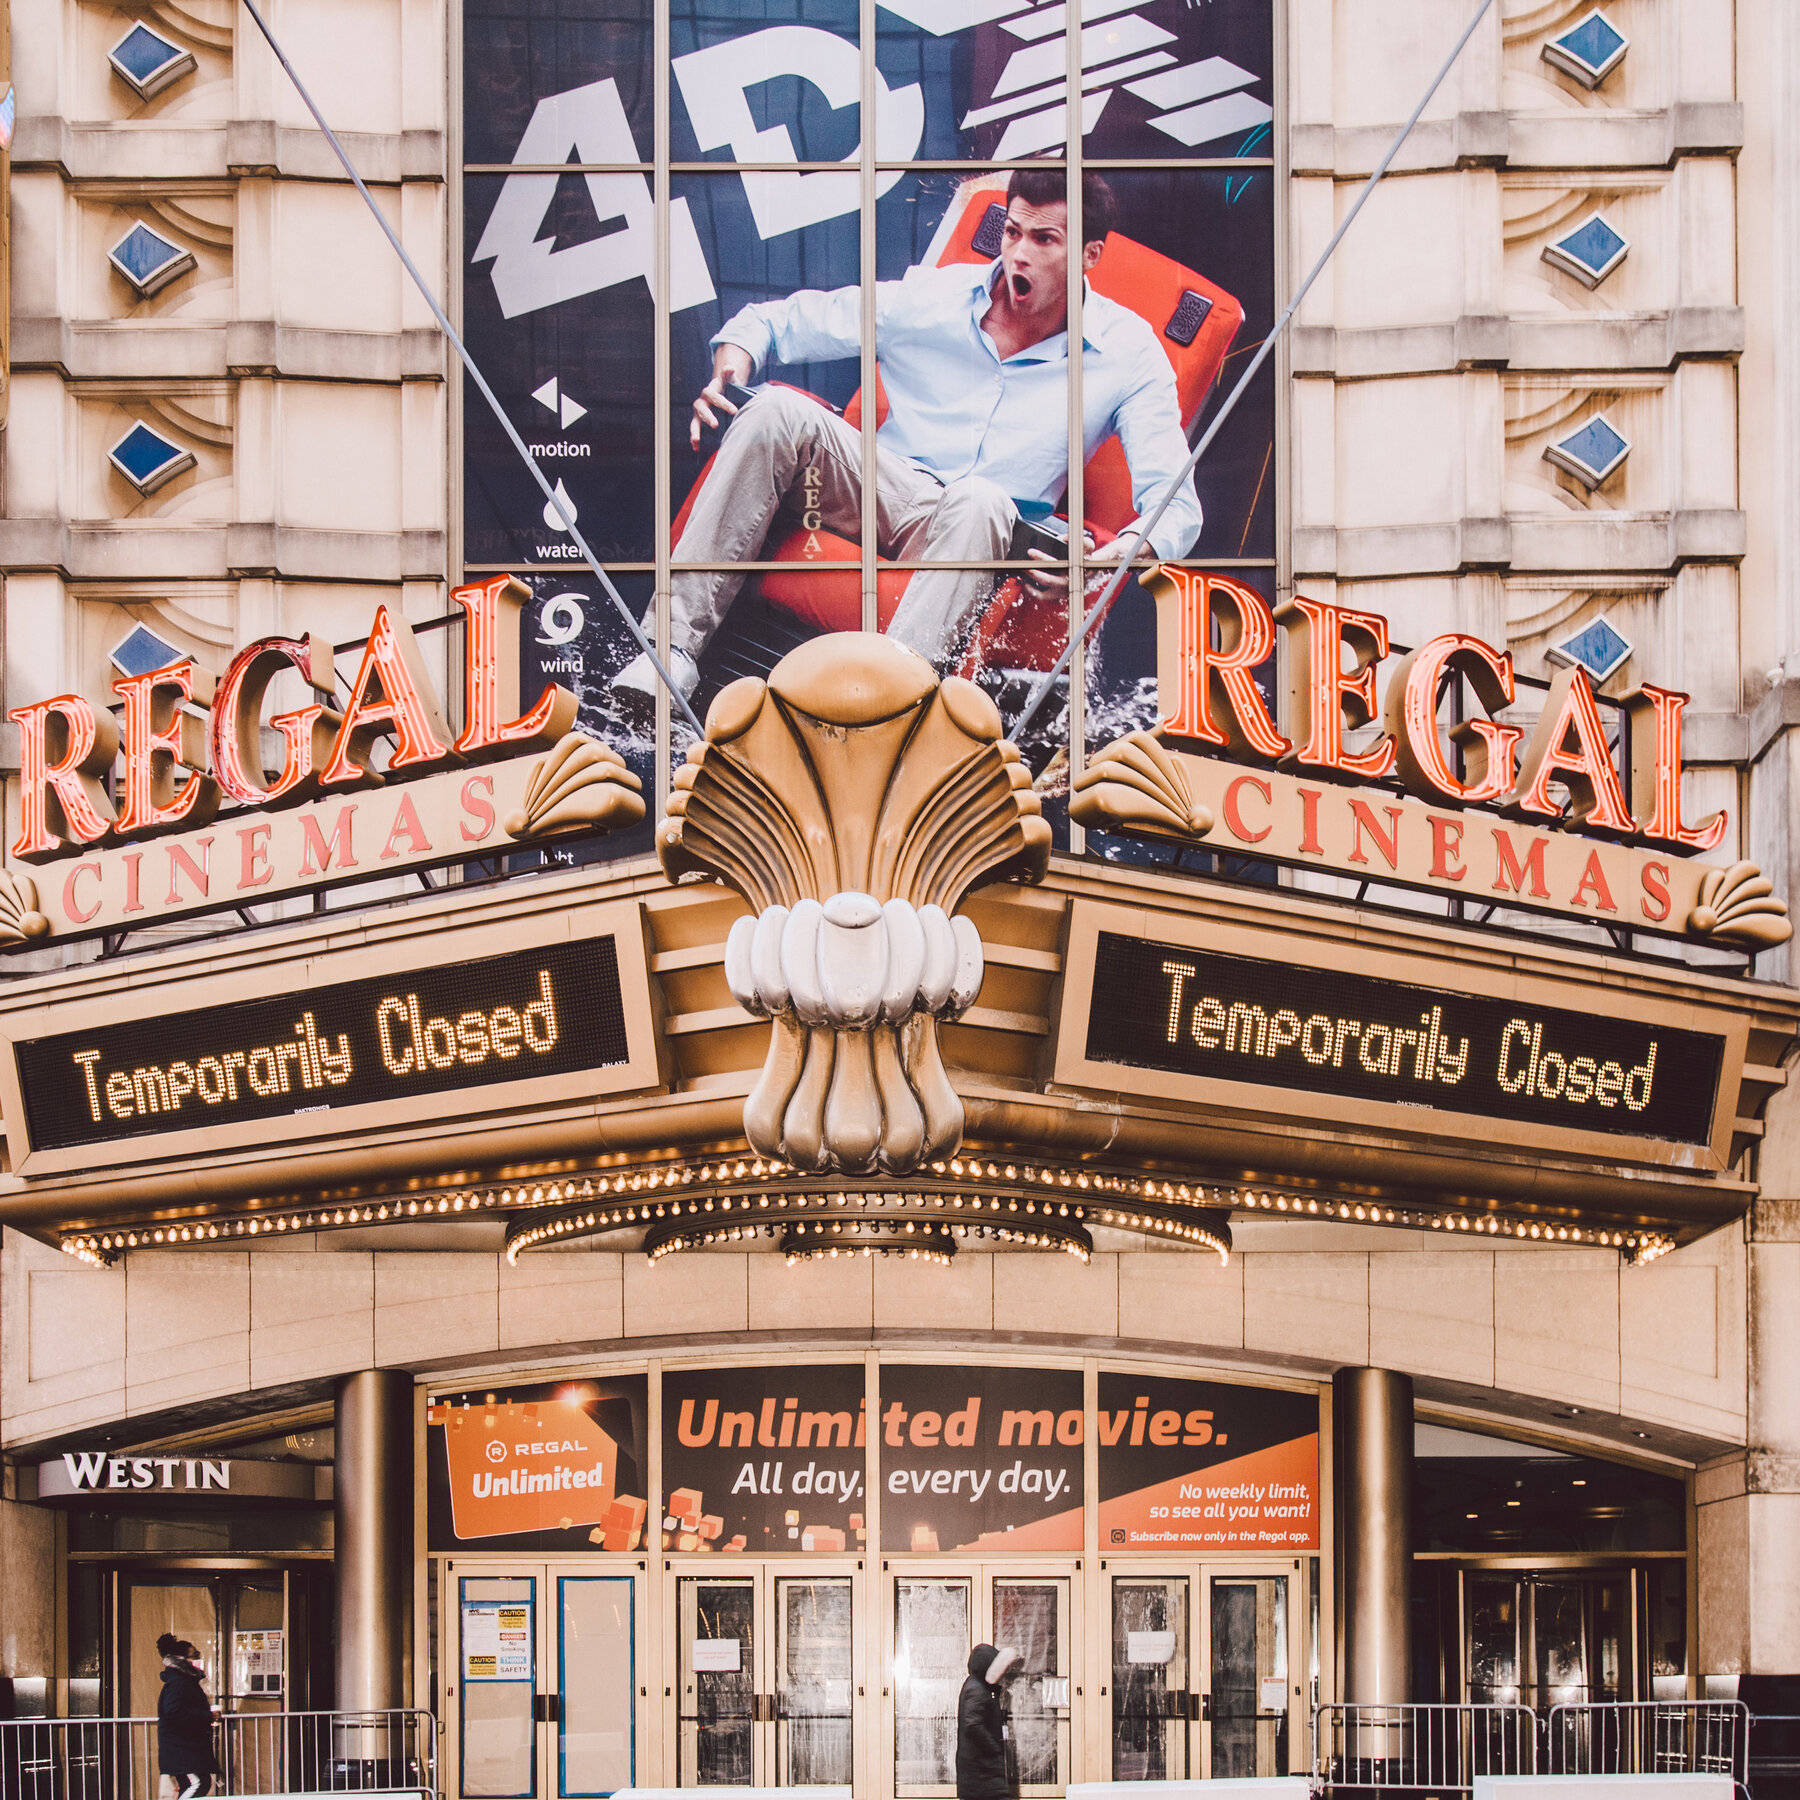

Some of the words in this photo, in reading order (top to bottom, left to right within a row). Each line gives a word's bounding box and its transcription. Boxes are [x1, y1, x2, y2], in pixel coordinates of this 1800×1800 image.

[528, 441, 591, 457] motion
[540, 656, 584, 673] wind
[10, 573, 558, 858] REGAL
[1157, 563, 1728, 852] REGAL
[62, 775, 496, 924] CINEMAS
[540, 850, 575, 865] liht
[1223, 774, 1672, 922] CINEMAS
[73, 1012, 352, 1122] Temporarily
[377, 969, 560, 1075] Closed
[1162, 960, 1469, 1085] Temporarily
[1499, 1017, 1657, 1112] Closed
[677, 1397, 981, 1448] Unlimited
[999, 1396, 1228, 1447] movies.
[514, 1440, 588, 1456] REGAL
[472, 1462, 604, 1498] Unlimited
[731, 1461, 784, 1495] All
[791, 1461, 864, 1504] day,
[888, 1469, 992, 1502] every
[998, 1460, 1071, 1502] day.
[1180, 1484, 1202, 1499] No
[1206, 1483, 1265, 1502] weekly
[1268, 1483, 1310, 1500] limit,
[1149, 1506, 1169, 1518] so
[1172, 1506, 1200, 1518] see
[1204, 1503, 1225, 1518] all
[1228, 1506, 1259, 1521] you
[1263, 1503, 1311, 1518] want!
[1130, 1531, 1178, 1541] Subscribe
[1180, 1533, 1202, 1541] now
[1204, 1531, 1228, 1544] only
[1228, 1531, 1237, 1541] in
[1239, 1531, 1256, 1541] the
[1258, 1531, 1287, 1544] Regal
[469, 1656, 496, 1664] CAUTION
